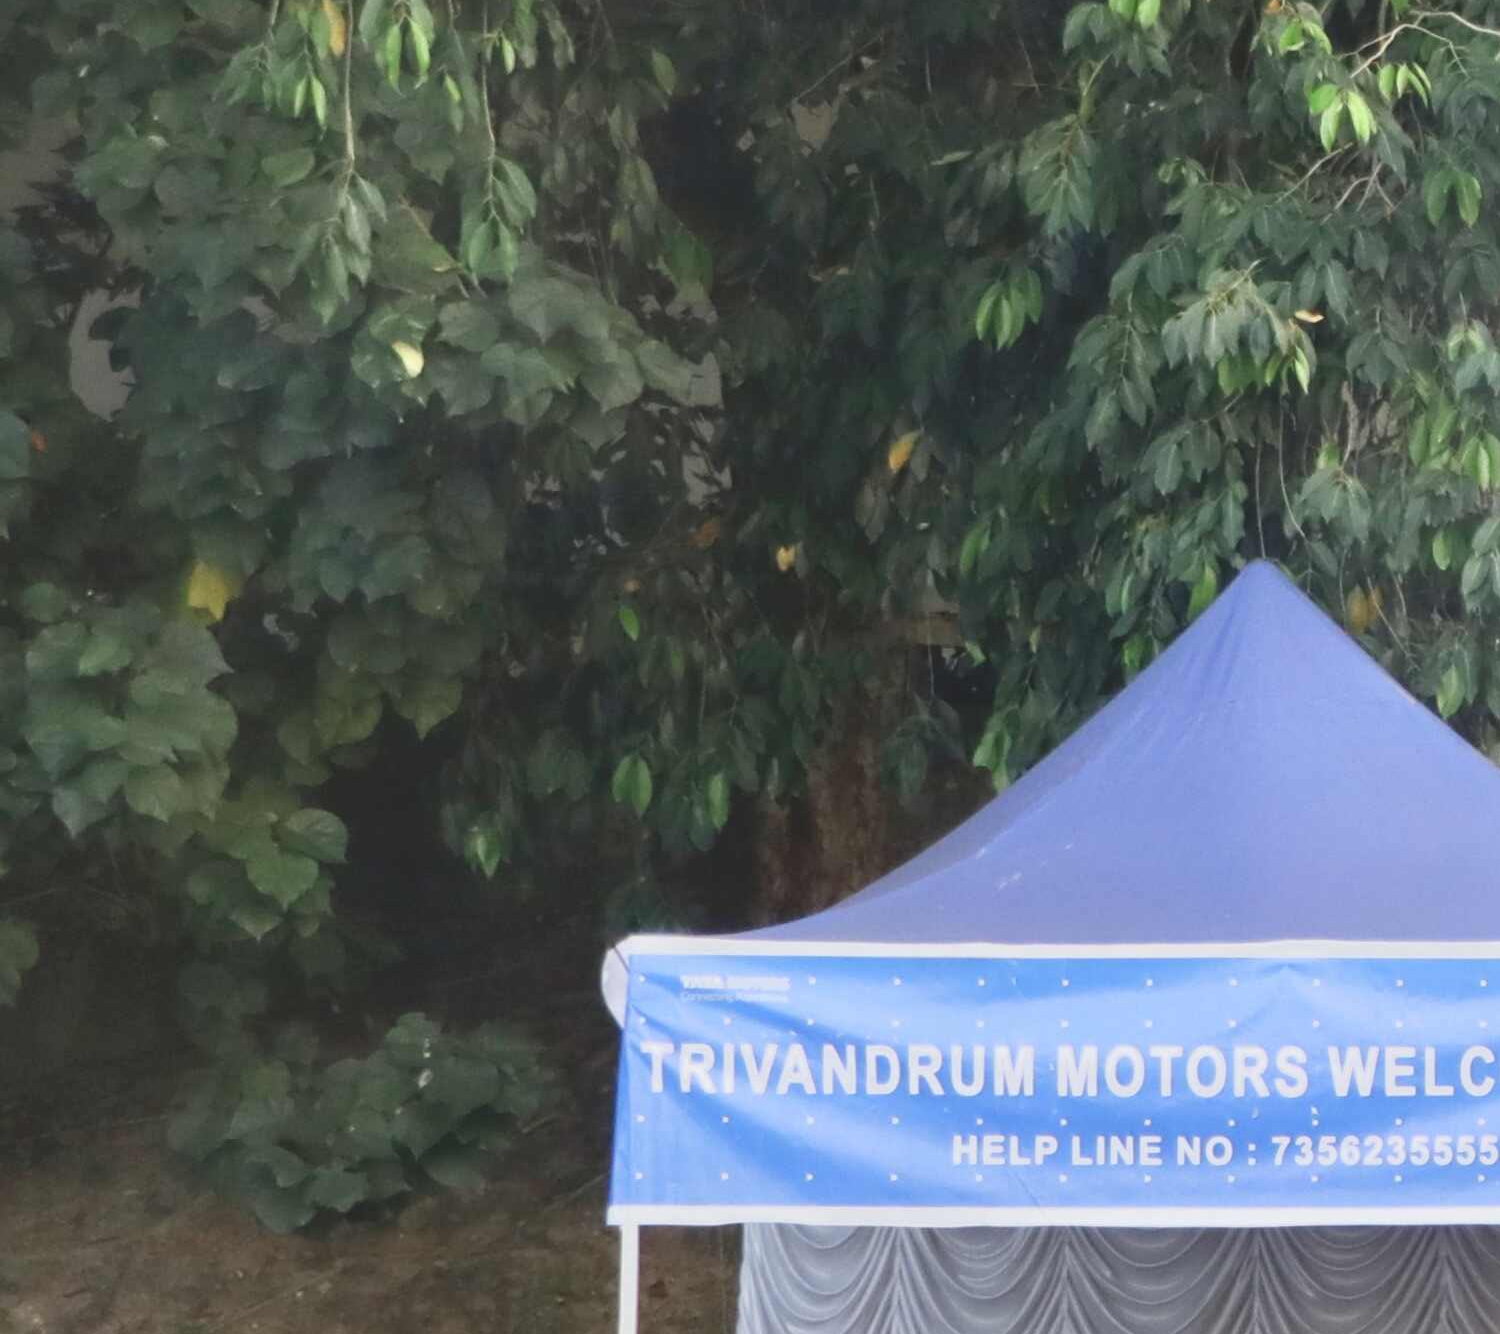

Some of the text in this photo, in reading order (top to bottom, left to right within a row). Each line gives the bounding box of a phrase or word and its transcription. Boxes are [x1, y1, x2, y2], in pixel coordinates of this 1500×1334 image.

[640, 1039, 1036, 1096] TRIVANDRUM
[1057, 1044, 1309, 1098] MOTORS
[952, 1134, 1059, 1165] HELP
[1072, 1135, 1163, 1165] LINE
[1177, 1136, 1234, 1166] NO
[1272, 1134, 1499, 1166] 7356235555
